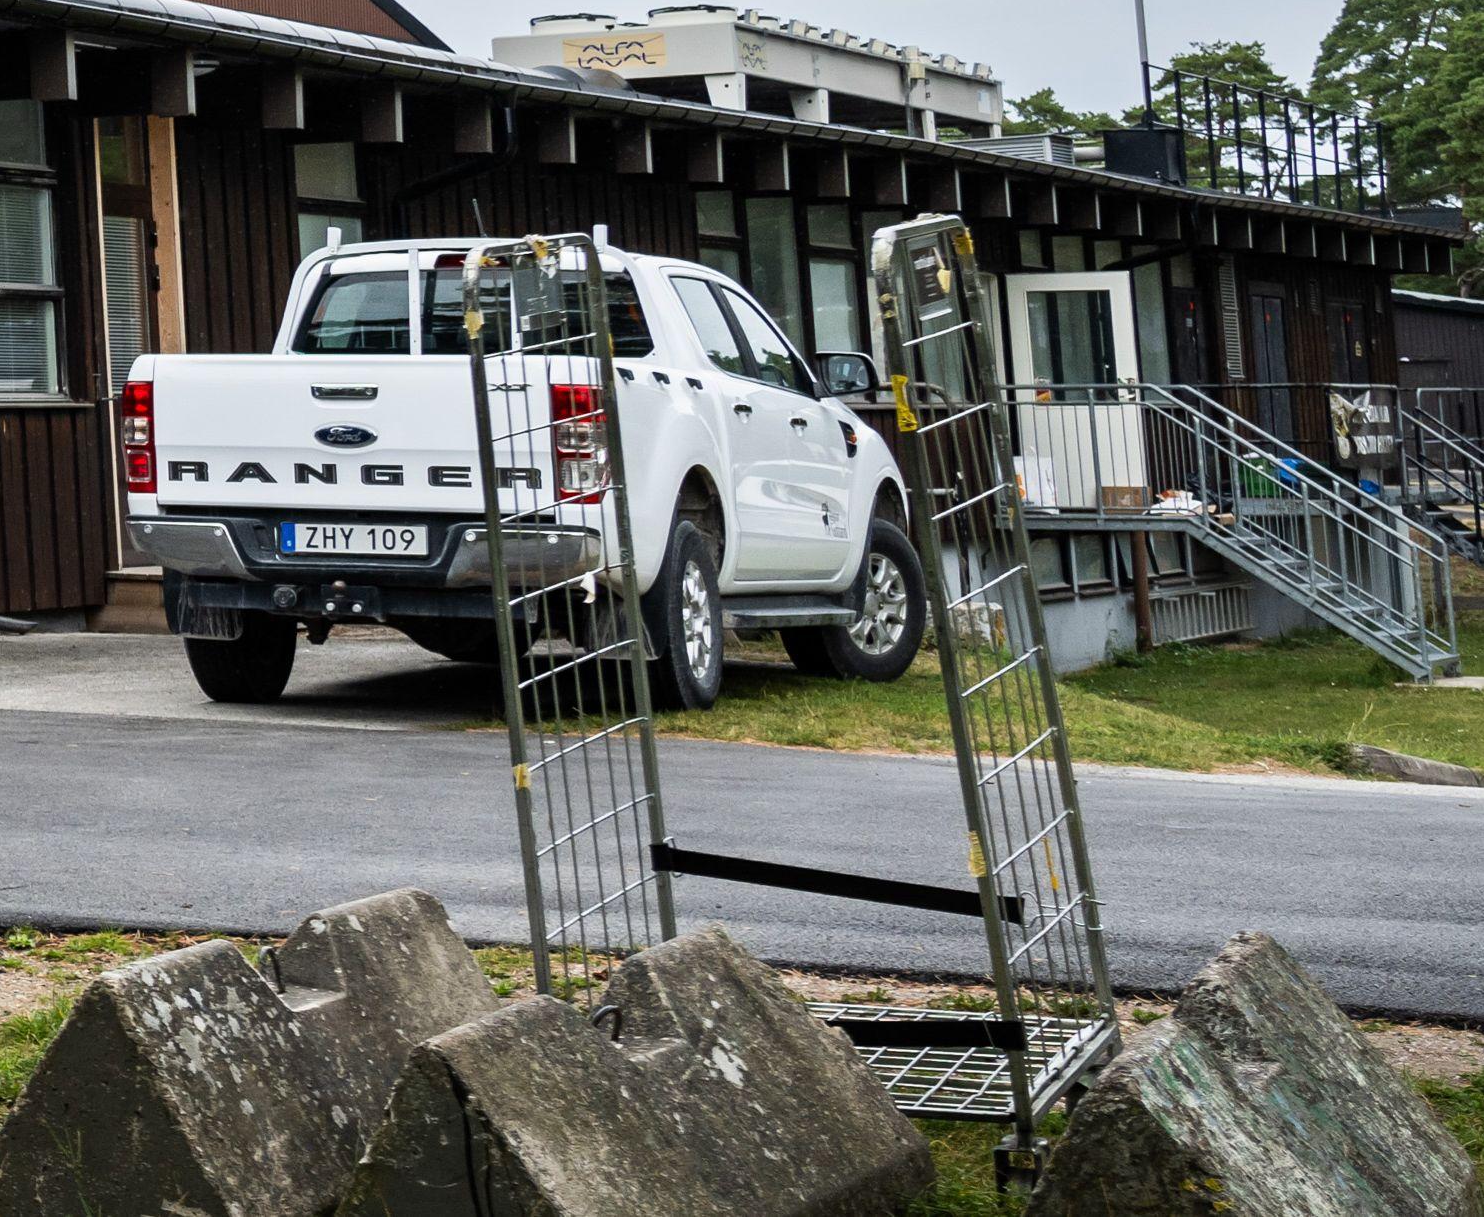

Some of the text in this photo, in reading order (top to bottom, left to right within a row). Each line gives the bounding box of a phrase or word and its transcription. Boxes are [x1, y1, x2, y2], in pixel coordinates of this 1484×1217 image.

[583, 41, 644, 55] ALFA
[577, 53, 657, 70] LAVAL
[326, 426, 362, 442] Ford
[167, 460, 543, 490] RANGER
[305, 526, 354, 550] ZHY
[367, 528, 415, 551] 109
